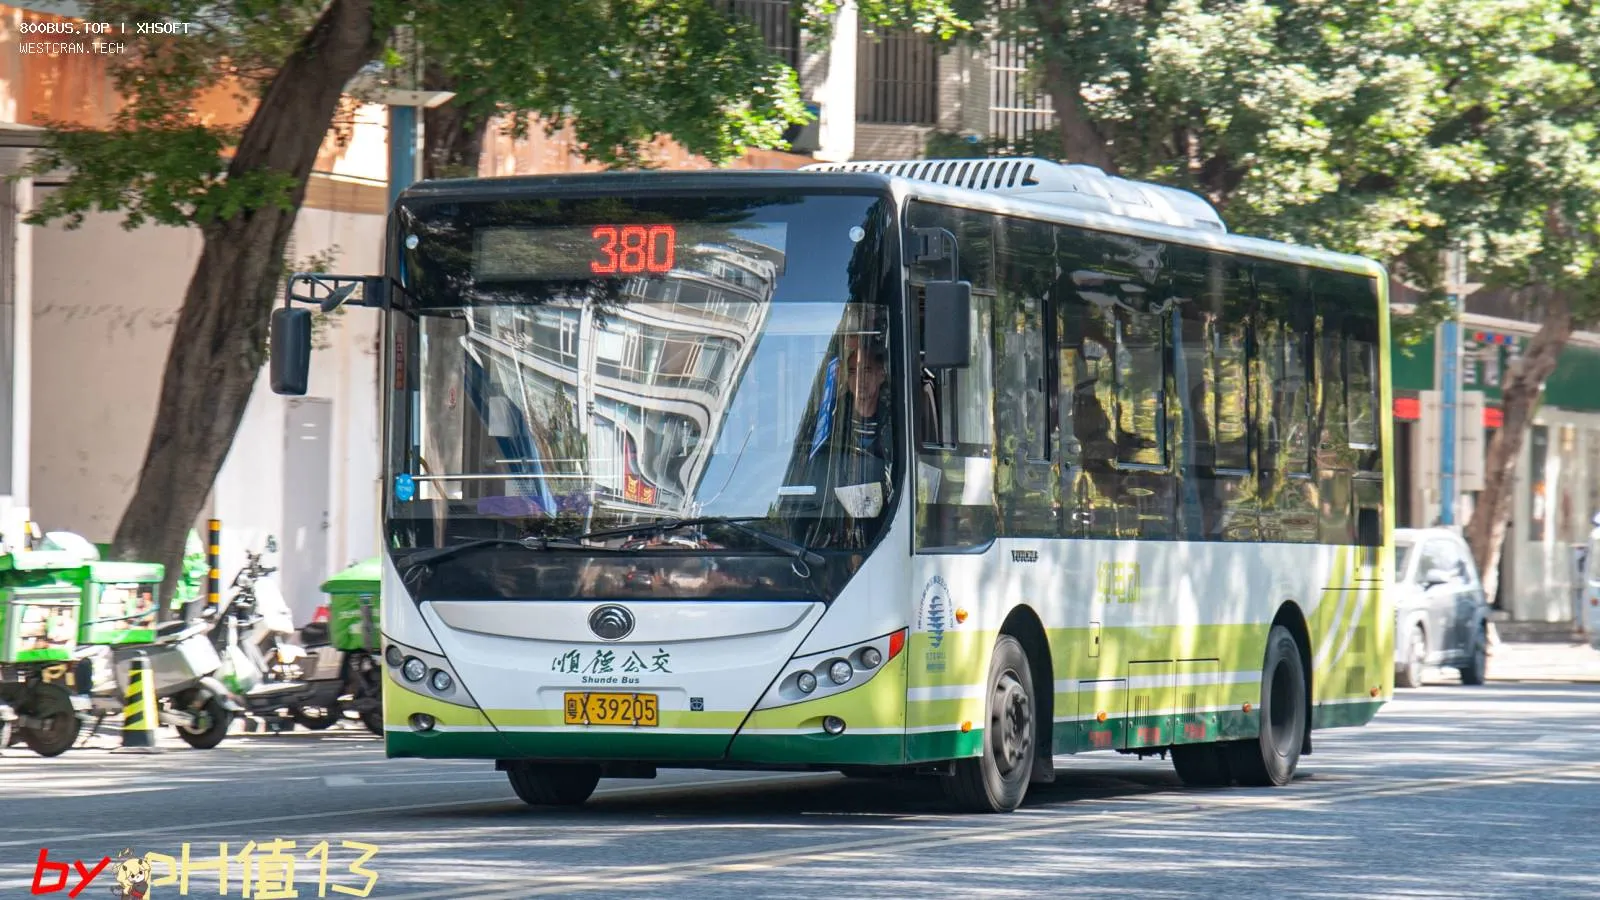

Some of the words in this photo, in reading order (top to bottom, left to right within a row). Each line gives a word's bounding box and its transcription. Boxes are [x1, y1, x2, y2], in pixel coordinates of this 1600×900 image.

[590, 224, 677, 273] 380
[581, 675, 618, 685] Shunde
[621, 676, 640, 685] Bus
